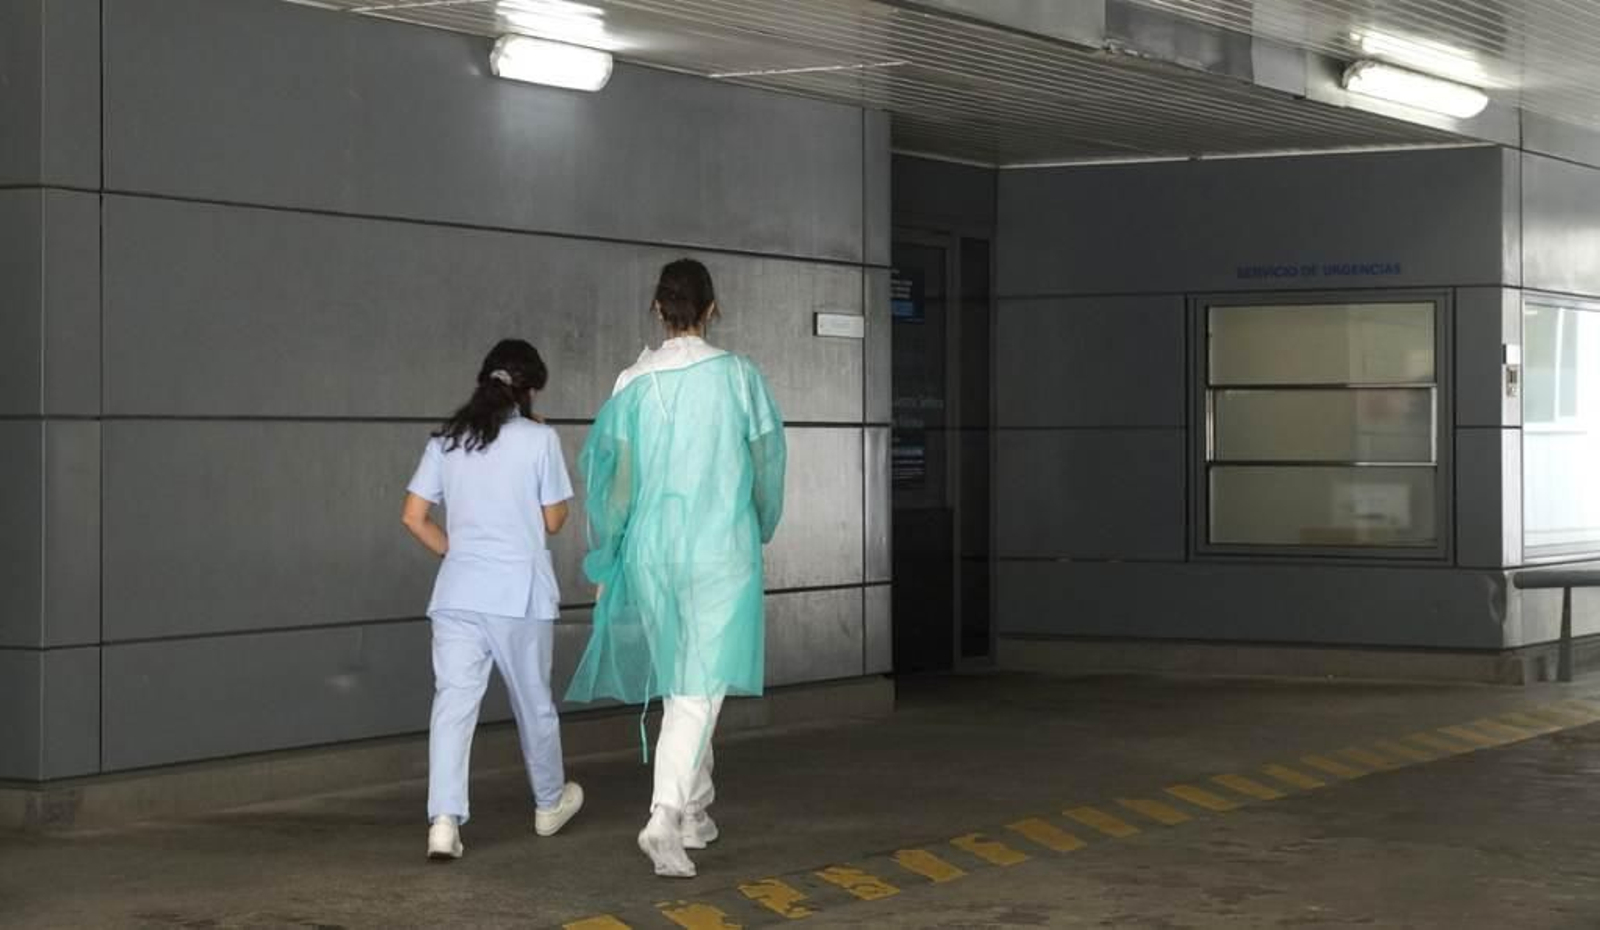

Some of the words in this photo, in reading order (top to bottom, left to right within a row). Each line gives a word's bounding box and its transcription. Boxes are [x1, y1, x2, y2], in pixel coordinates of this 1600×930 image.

[1237, 264, 1298, 278] SERVICIO
[1301, 264, 1318, 277] DE
[1323, 263, 1402, 276] URGENCIAS
